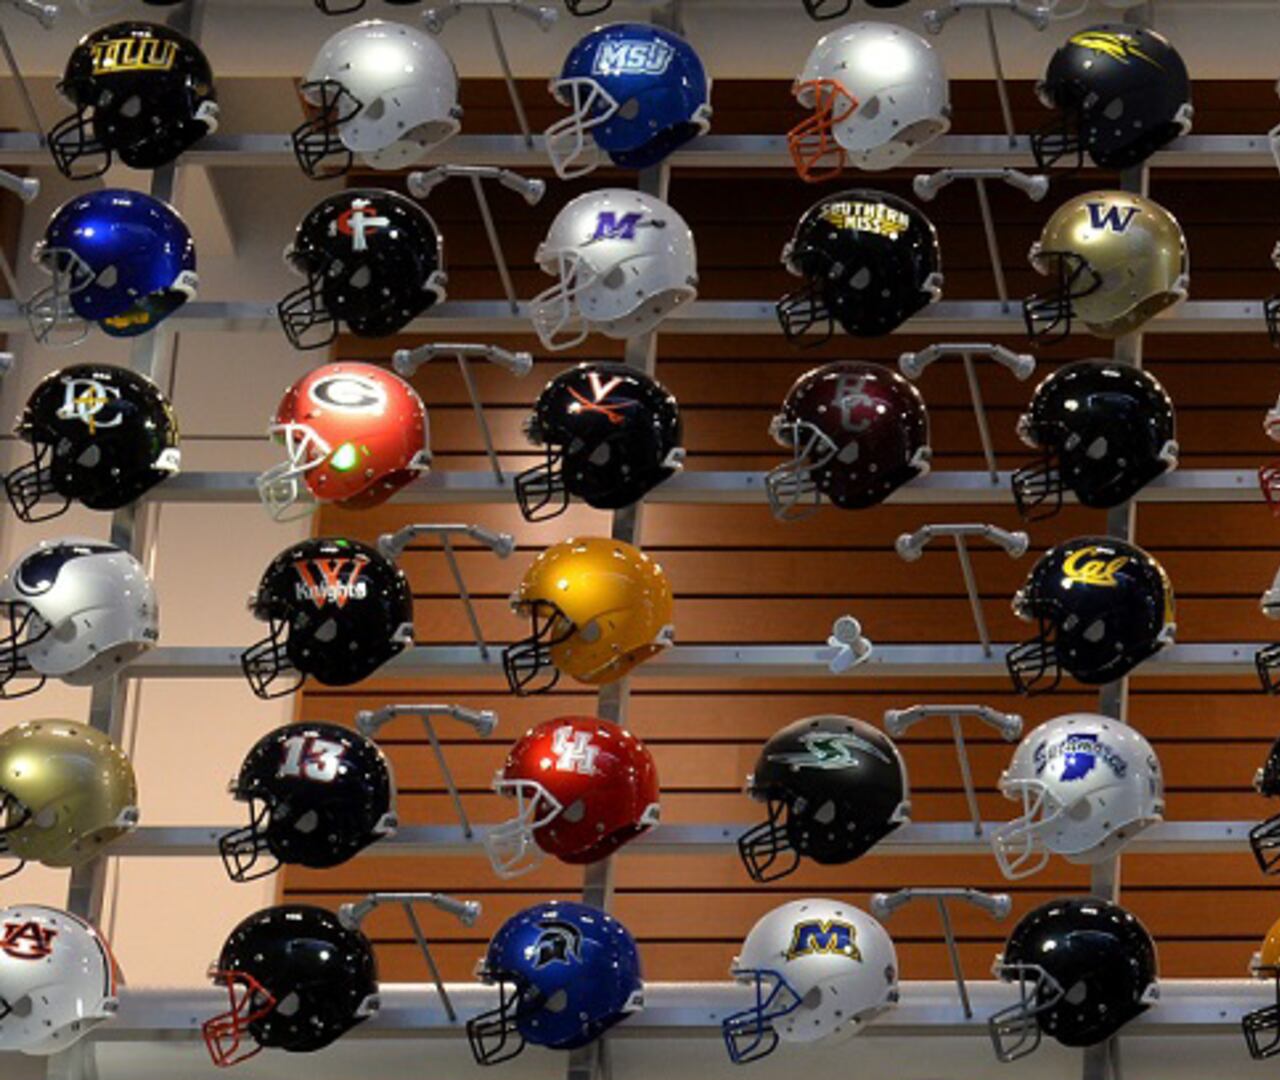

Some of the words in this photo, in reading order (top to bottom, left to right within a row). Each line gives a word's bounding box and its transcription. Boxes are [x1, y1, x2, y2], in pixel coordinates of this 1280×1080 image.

[592, 39, 675, 74] MSU
[593, 211, 640, 239] M
[821, 202, 910, 230] SOUTHERN
[843, 215, 881, 233] MISS
[1085, 203, 1140, 231] W
[313, 379, 382, 408] G
[589, 374, 622, 401] V
[1062, 547, 1127, 587] Cal
[282, 736, 343, 781] 13
[785, 919, 862, 962] M
